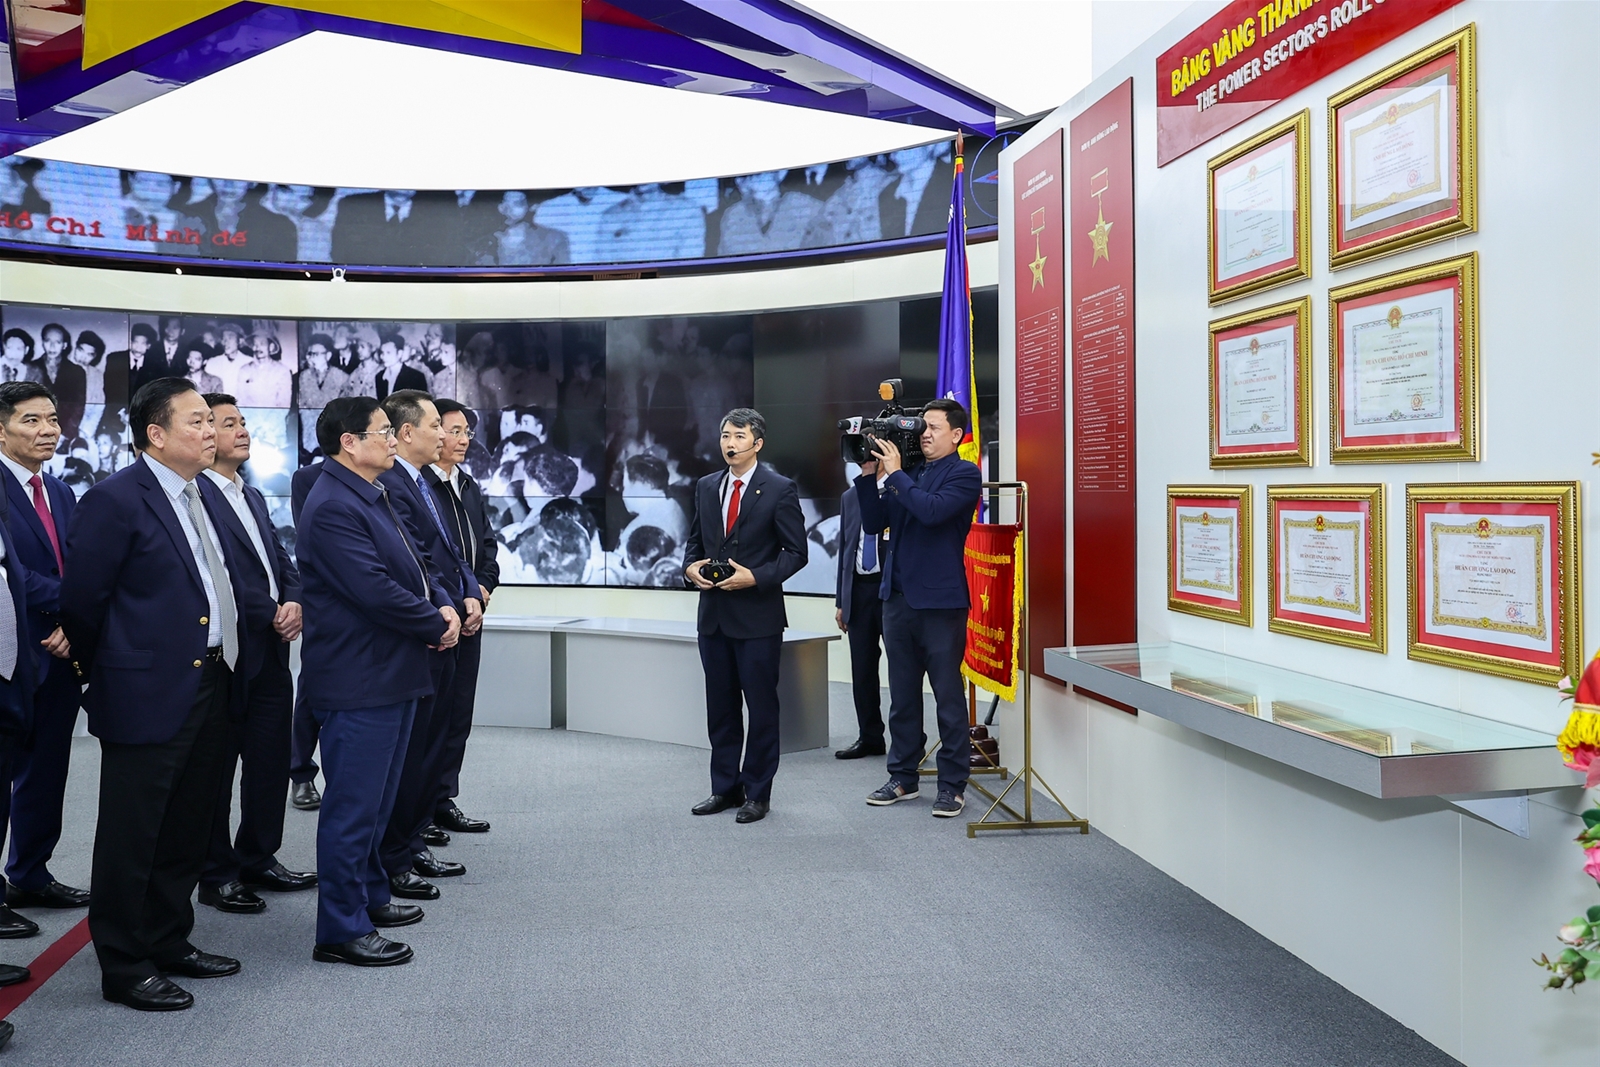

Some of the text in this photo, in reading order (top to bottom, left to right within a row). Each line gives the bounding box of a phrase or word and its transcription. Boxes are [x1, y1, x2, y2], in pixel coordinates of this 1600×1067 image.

[1171, 57, 1211, 97] BẢNG
[1212, 17, 1256, 68] VÀNG
[1196, 0, 1373, 112] THE POWER SECTOR'S ROLL
[126, 224, 200, 245] Minh
